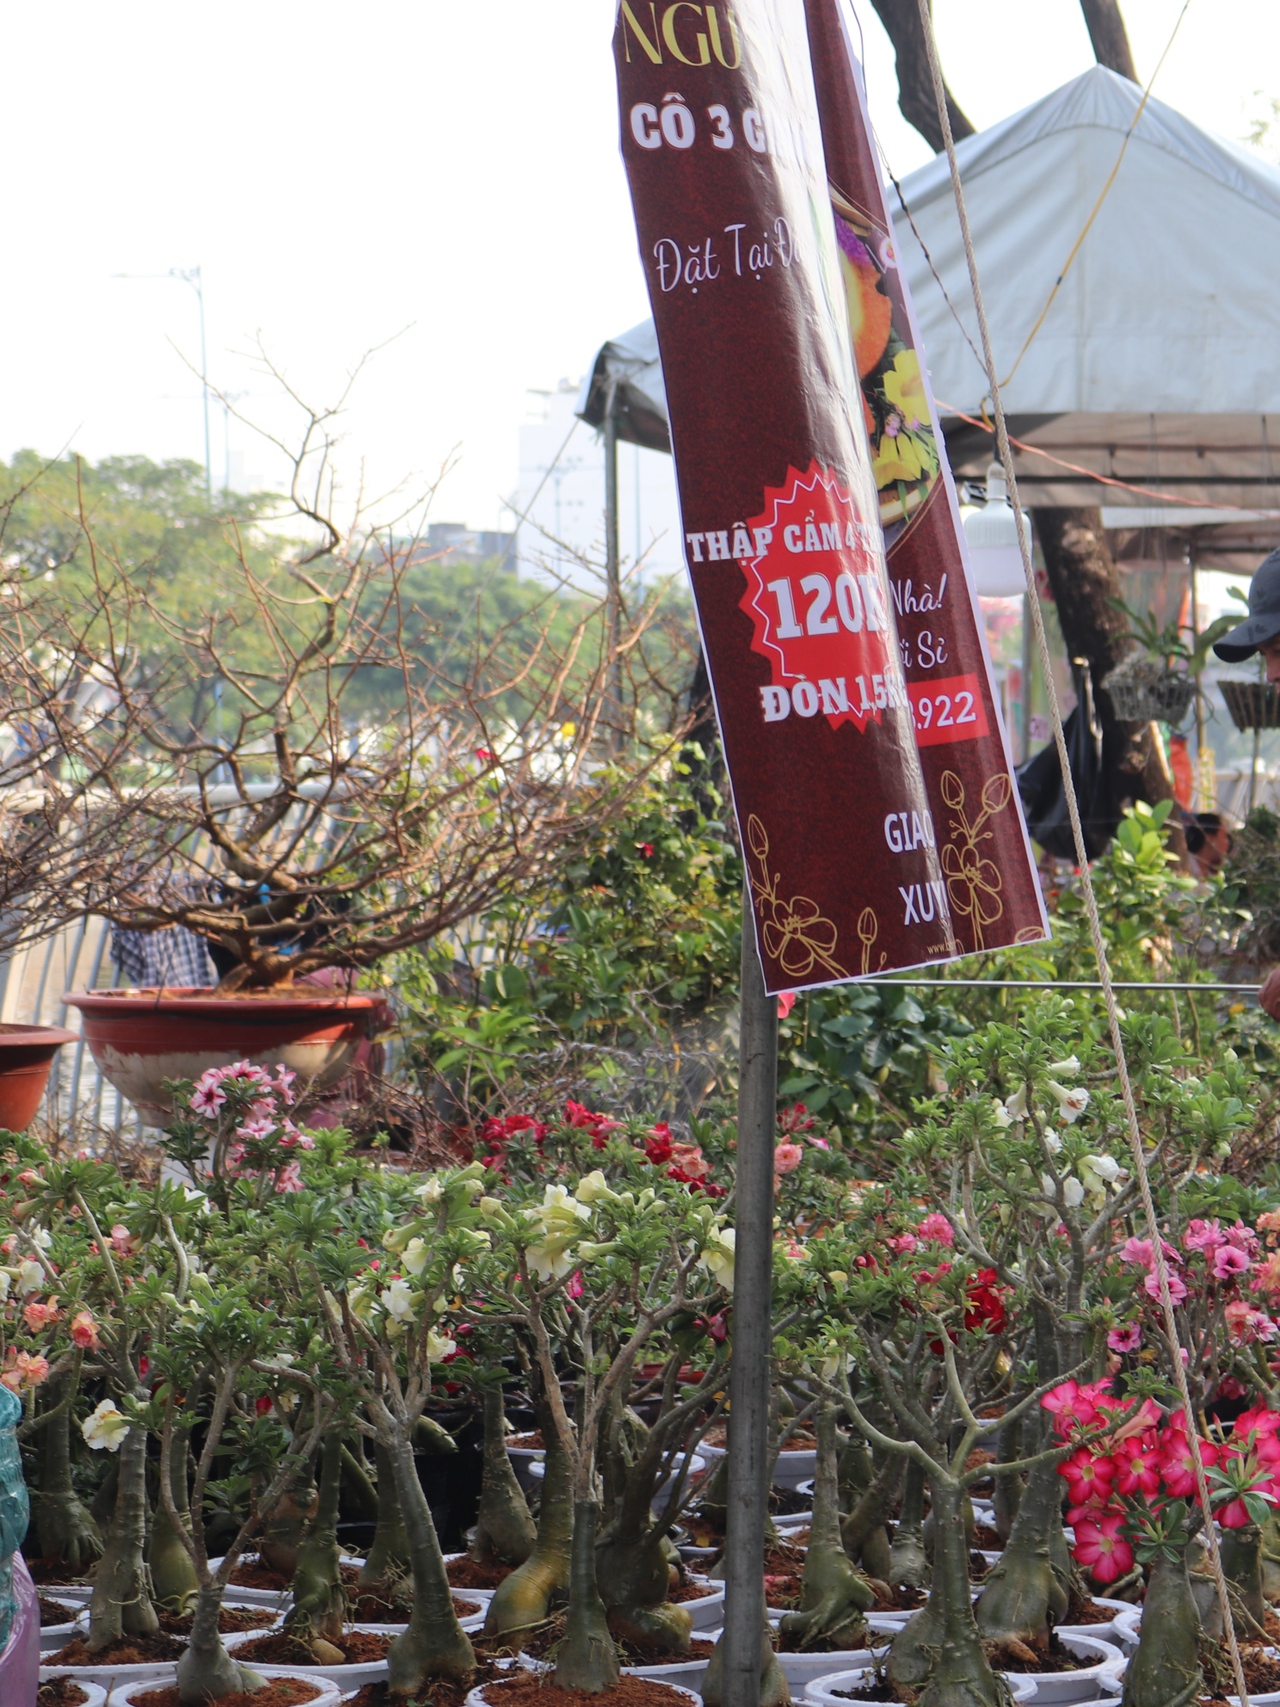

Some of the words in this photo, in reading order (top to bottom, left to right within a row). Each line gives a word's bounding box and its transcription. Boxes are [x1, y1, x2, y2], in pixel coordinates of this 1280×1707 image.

[630, 91, 696, 150] CÔ
[707, 103, 735, 150] 3
[653, 237, 721, 294] Đặt
[723, 223, 774, 281] Tại
[686, 521, 773, 566] THẬP
[783, 508, 843, 554] CẨM
[766, 571, 889, 640] 120K
[916, 629, 949, 670] Sỉ
[758, 673, 850, 723] ĐÒN
